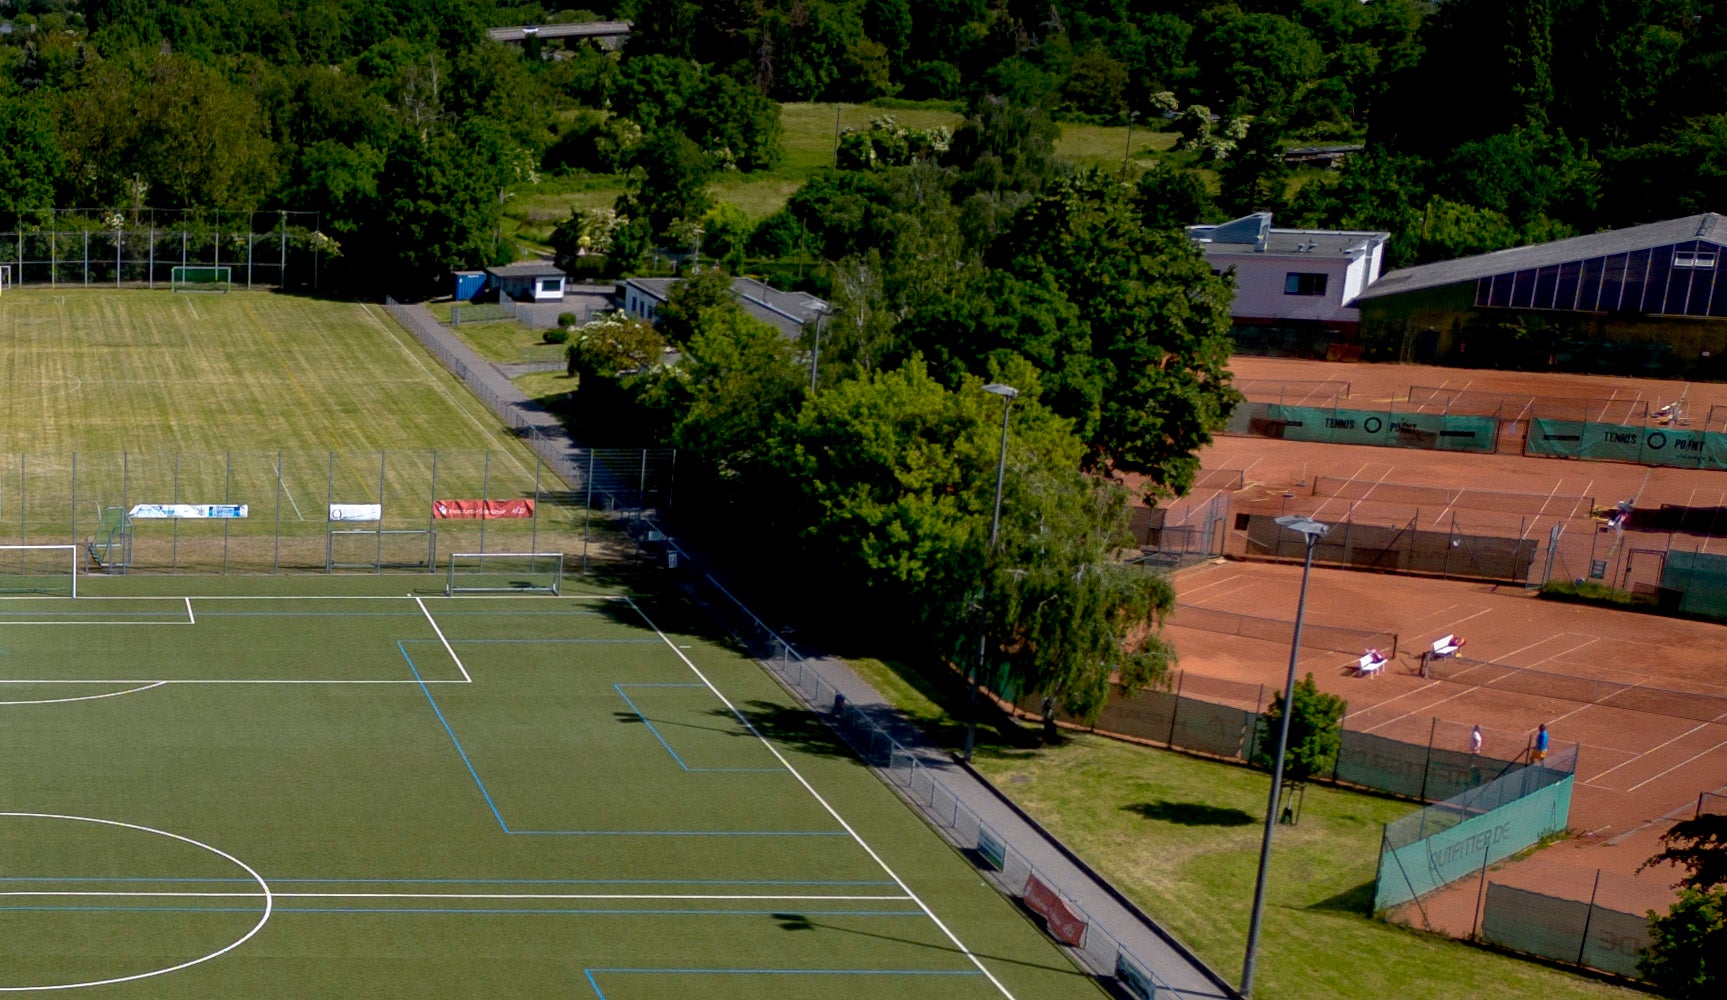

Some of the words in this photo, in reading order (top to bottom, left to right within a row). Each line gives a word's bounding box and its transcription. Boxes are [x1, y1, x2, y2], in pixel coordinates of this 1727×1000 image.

[1325, 418, 1356, 430] TENNIS
[1604, 432, 1637, 445] TENNIS
[1674, 437, 1705, 451] POINT
